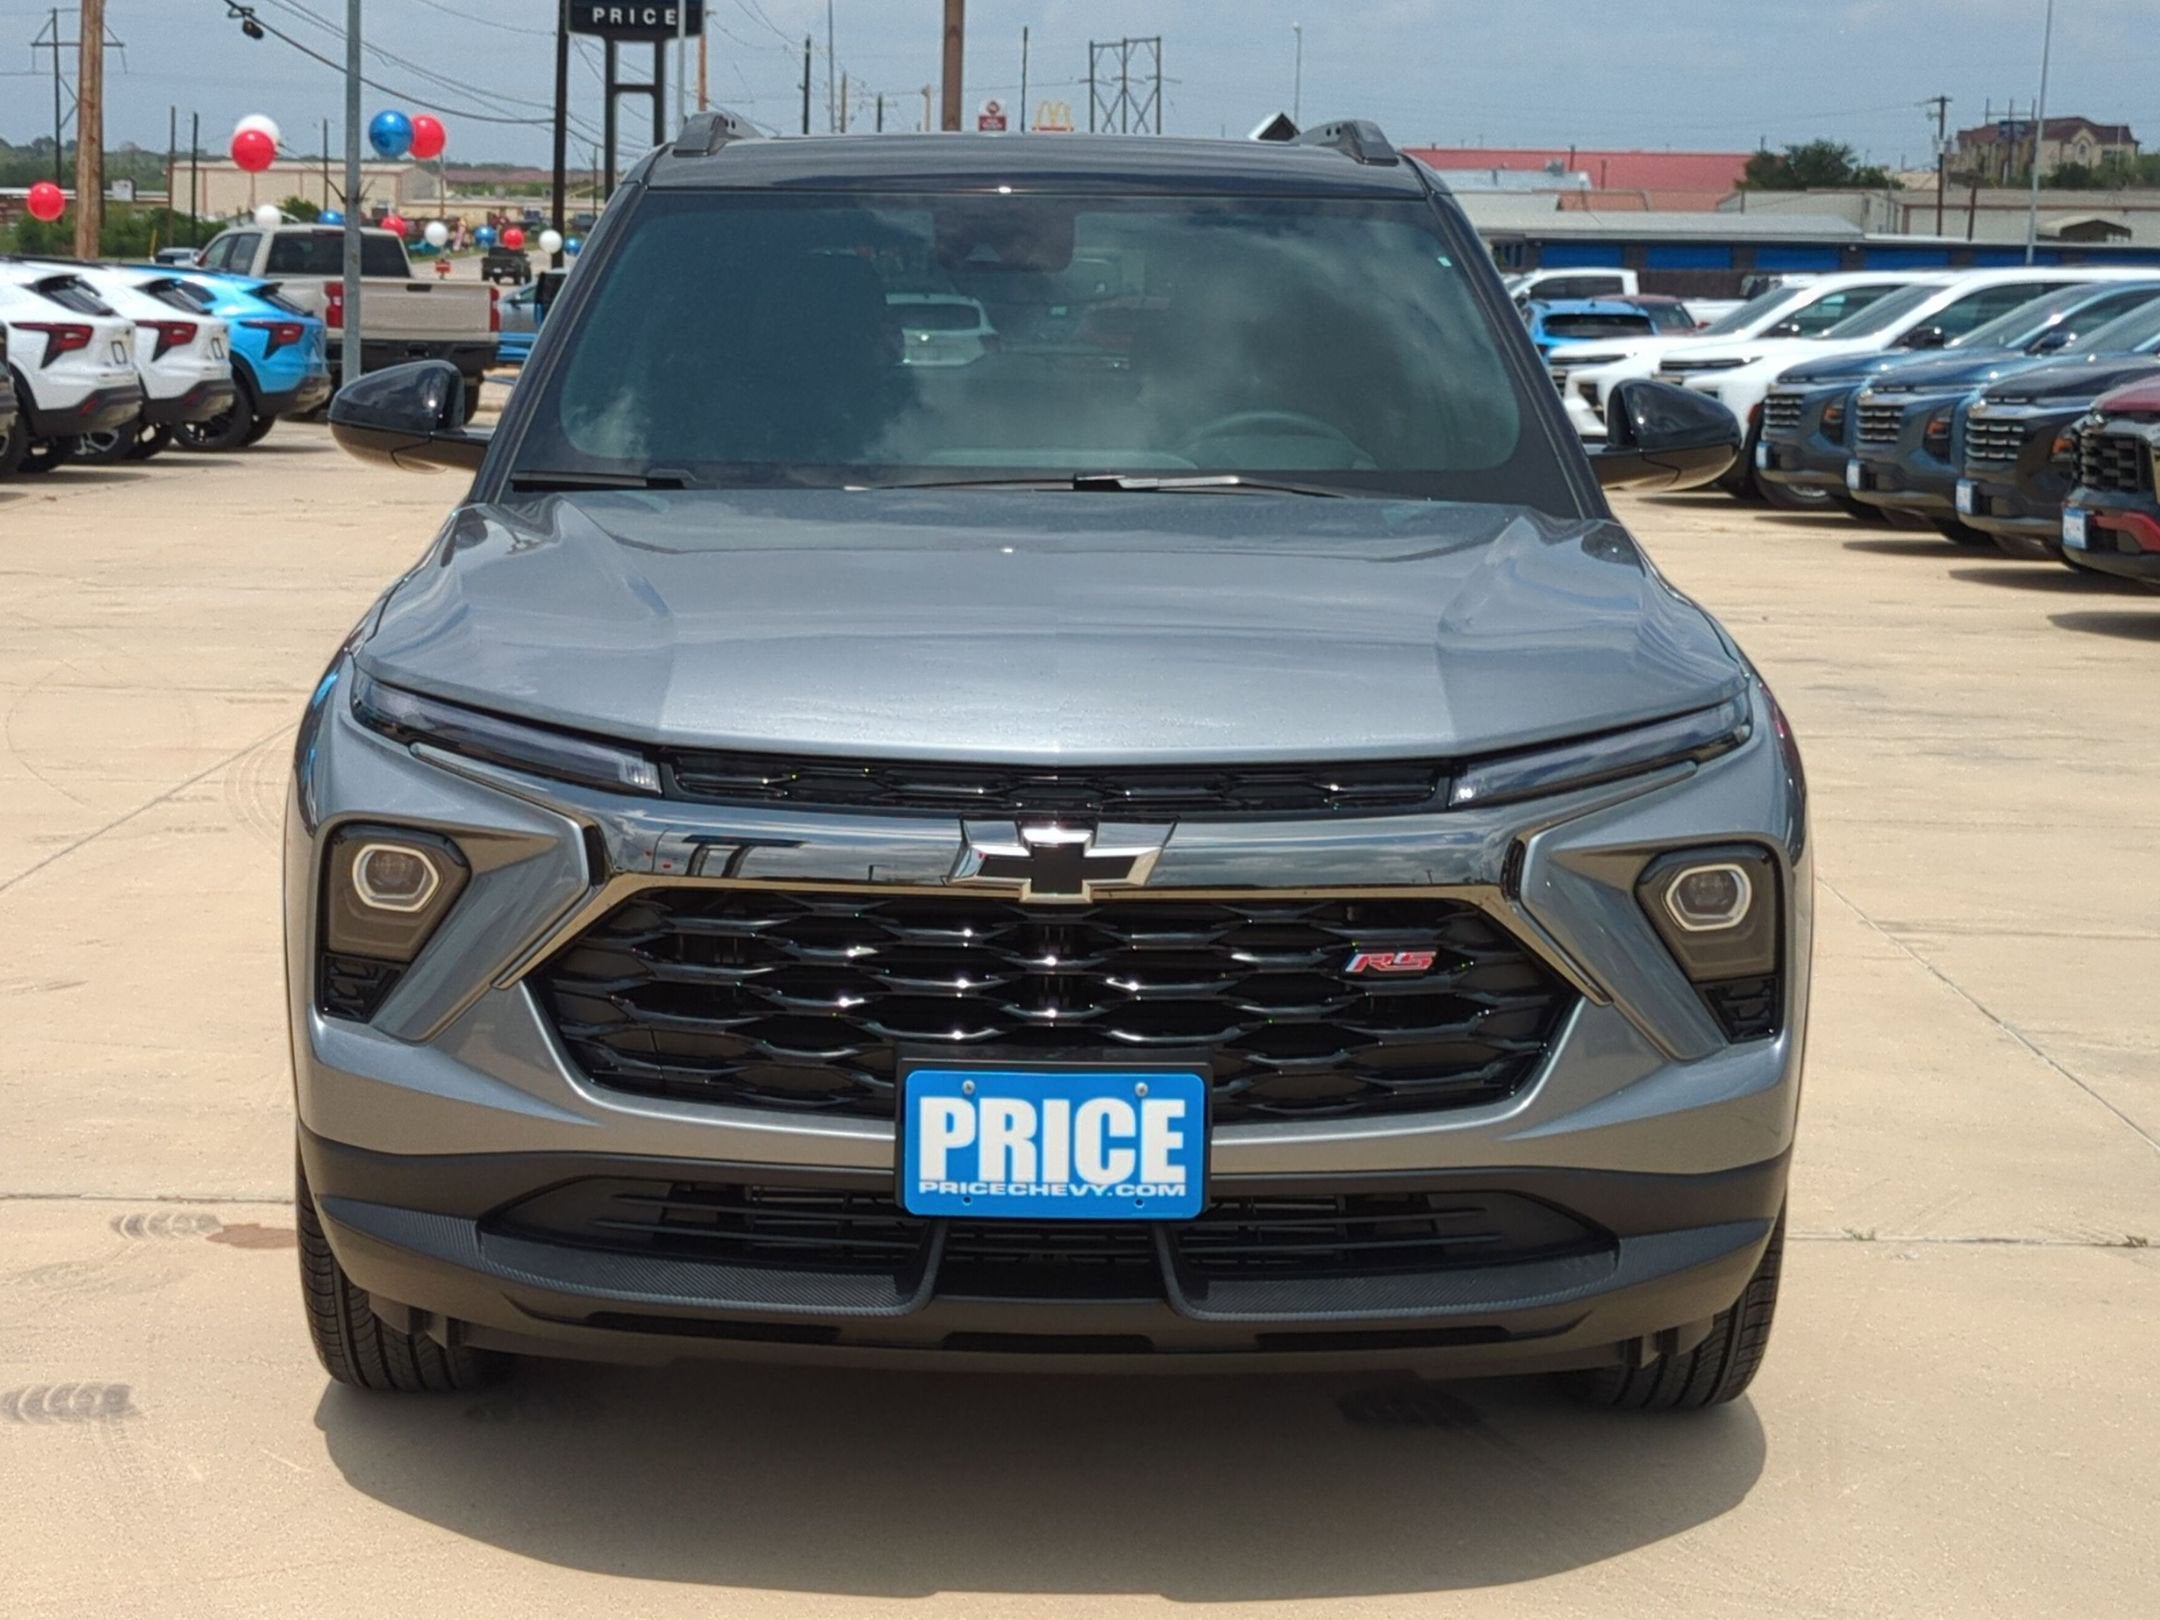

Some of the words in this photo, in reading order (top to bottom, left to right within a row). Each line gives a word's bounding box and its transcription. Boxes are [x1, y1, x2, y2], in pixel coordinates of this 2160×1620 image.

[592, 7, 677, 25] PRICE
[1345, 951, 1436, 972] RS
[919, 1096, 1186, 1184] PRICE
[919, 1181, 1186, 1197] PRICECHEVY.COM
